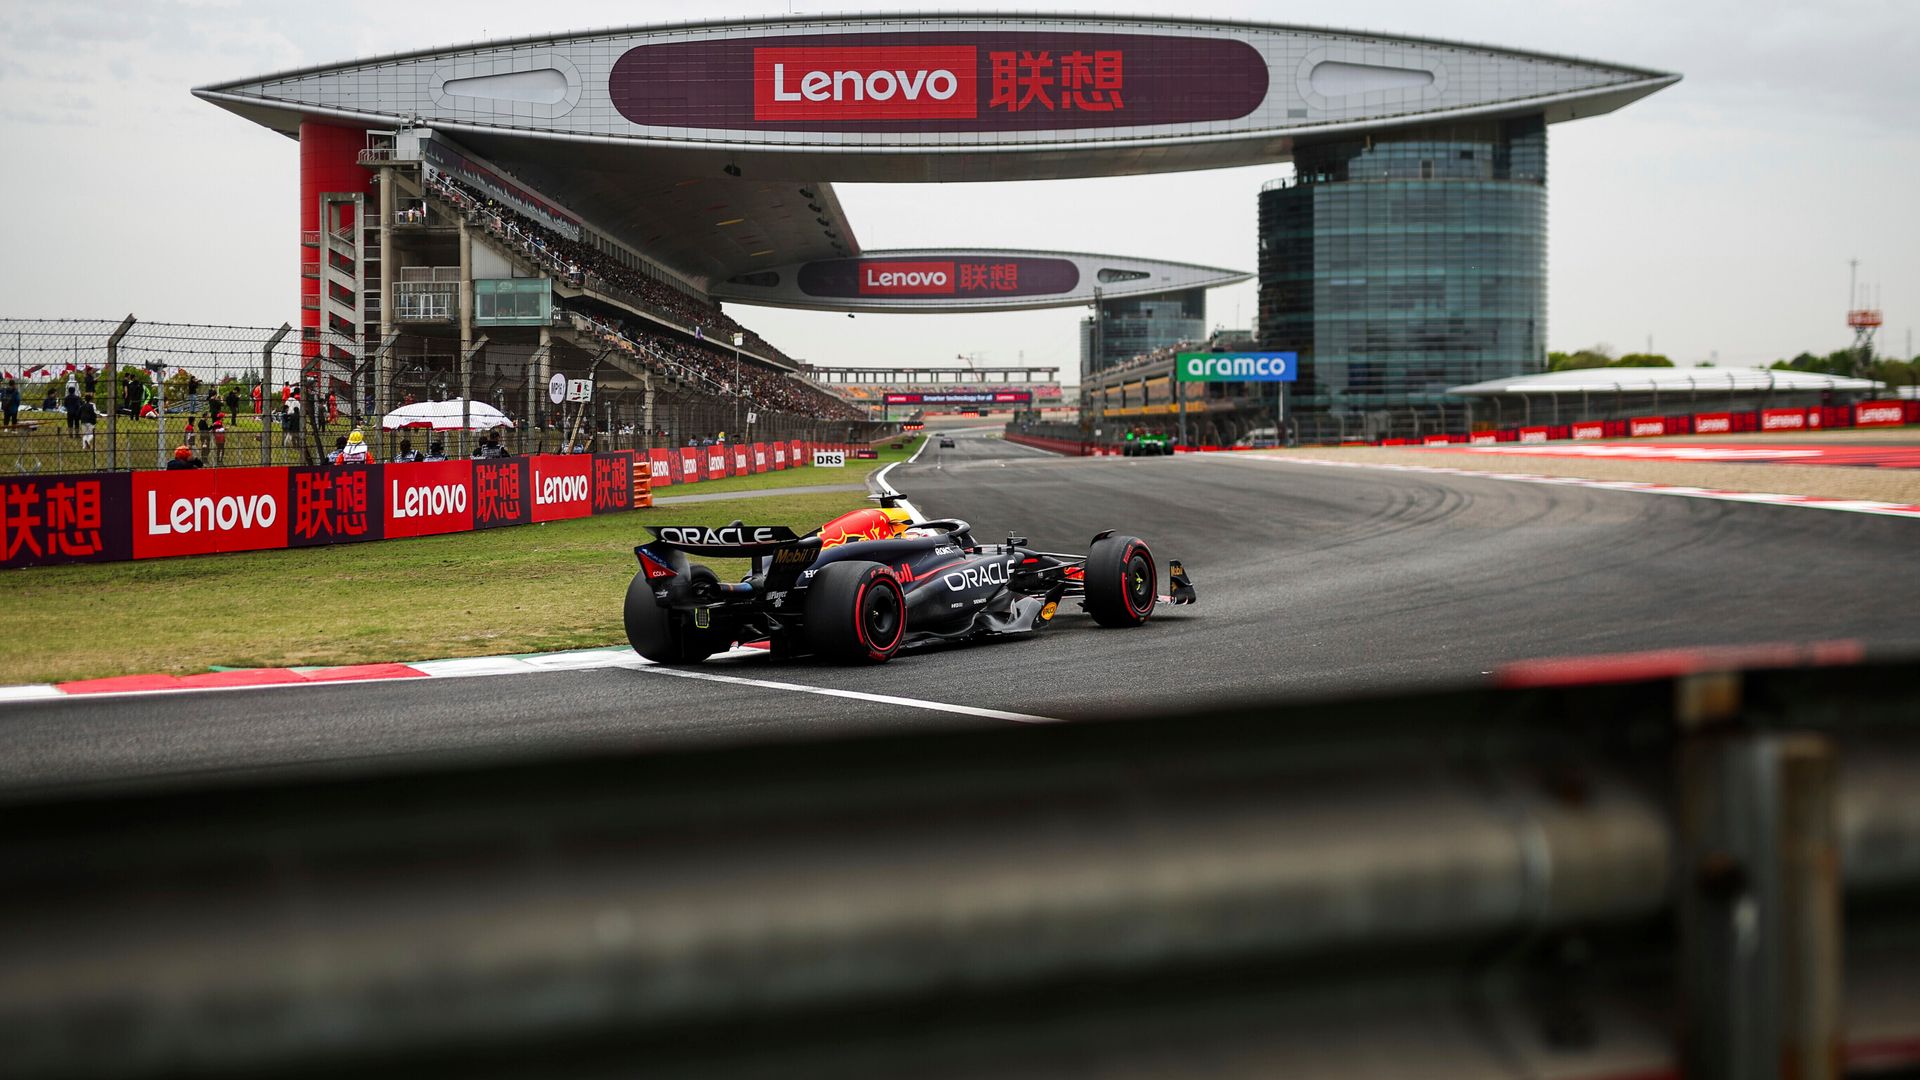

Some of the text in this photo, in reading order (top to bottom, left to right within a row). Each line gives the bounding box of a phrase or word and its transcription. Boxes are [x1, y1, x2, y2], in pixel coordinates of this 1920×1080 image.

[774, 63, 957, 101] Lenovo
[989, 50, 1124, 113] 联想
[867, 269, 947, 287] Lenovo
[959, 263, 1018, 290] 联想
[1187, 357, 1286, 376] aramco
[1764, 412, 1803, 429] Lenovo
[1857, 405, 1901, 424] Lenovo
[817, 455, 842, 464] DRS
[392, 479, 467, 518] Lenovo
[476, 463, 521, 523] 联想
[535, 470, 588, 505] Lenovo
[595, 457, 626, 513] 联想
[148, 490, 277, 535] Lenovo
[295, 470, 368, 539] 联想
[660, 527, 773, 545] ORACLE
[775, 548, 808, 563] Mobil
